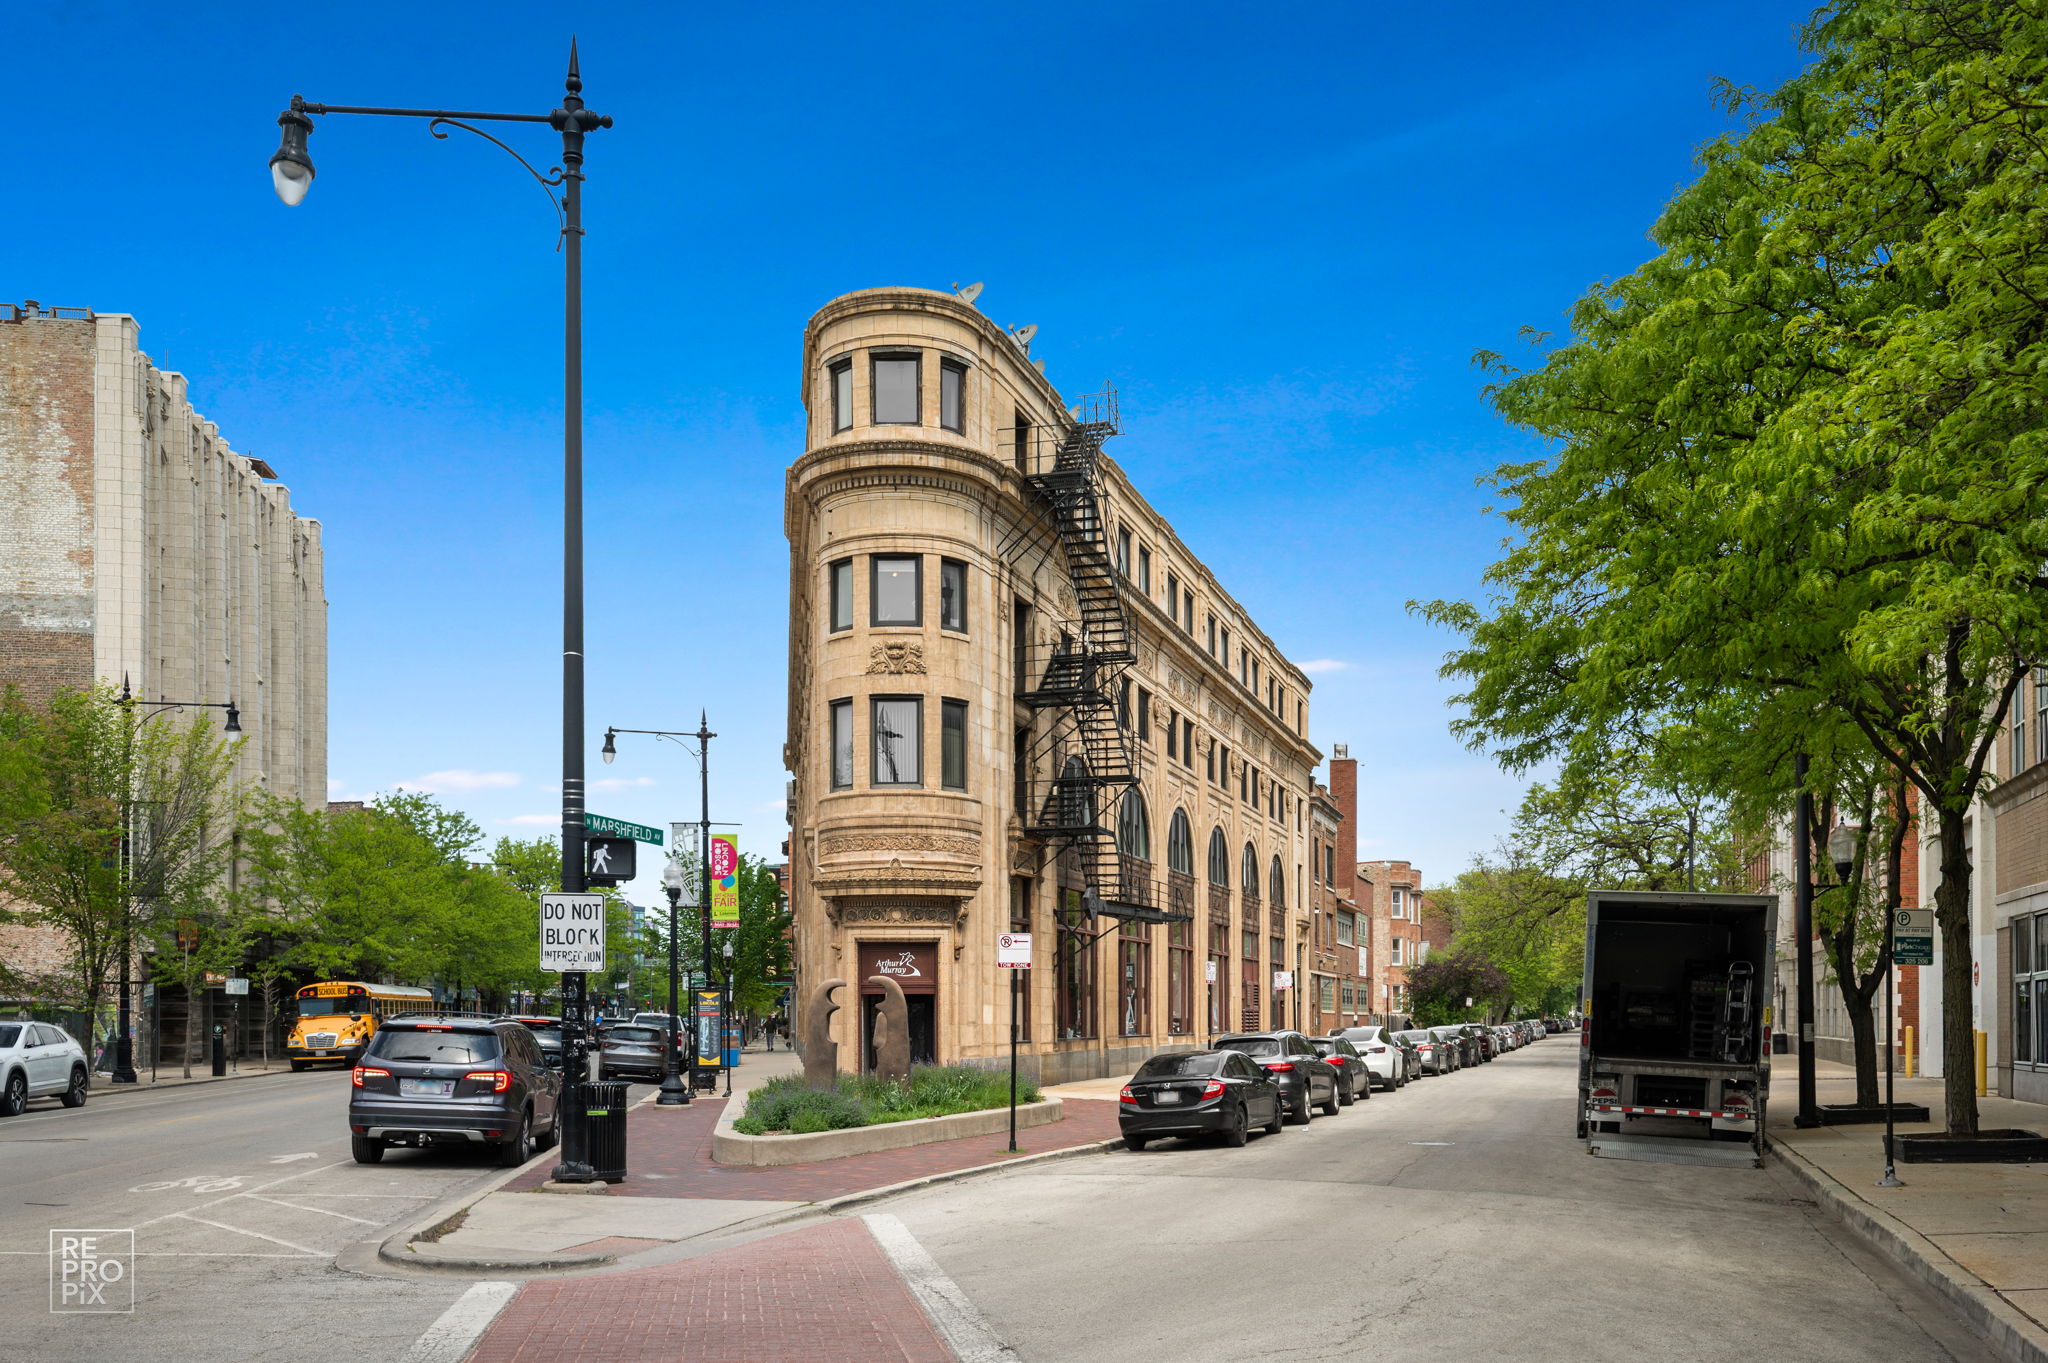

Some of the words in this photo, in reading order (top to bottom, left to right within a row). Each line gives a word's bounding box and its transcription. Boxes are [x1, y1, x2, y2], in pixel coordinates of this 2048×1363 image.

[592, 817, 652, 841] MARSHFIELD
[714, 842, 722, 876] ROSCOE
[721, 842, 729, 876] LINCOLN
[714, 897, 737, 907] FAIR
[544, 903, 565, 920] DO
[571, 903, 601, 920] NOT
[546, 928, 599, 945] BLOCK
[875, 959, 899, 967] Arthur
[880, 967, 906, 975] Murray
[319, 988, 336, 996] SCHOOL
[338, 987, 347, 995] BUS
